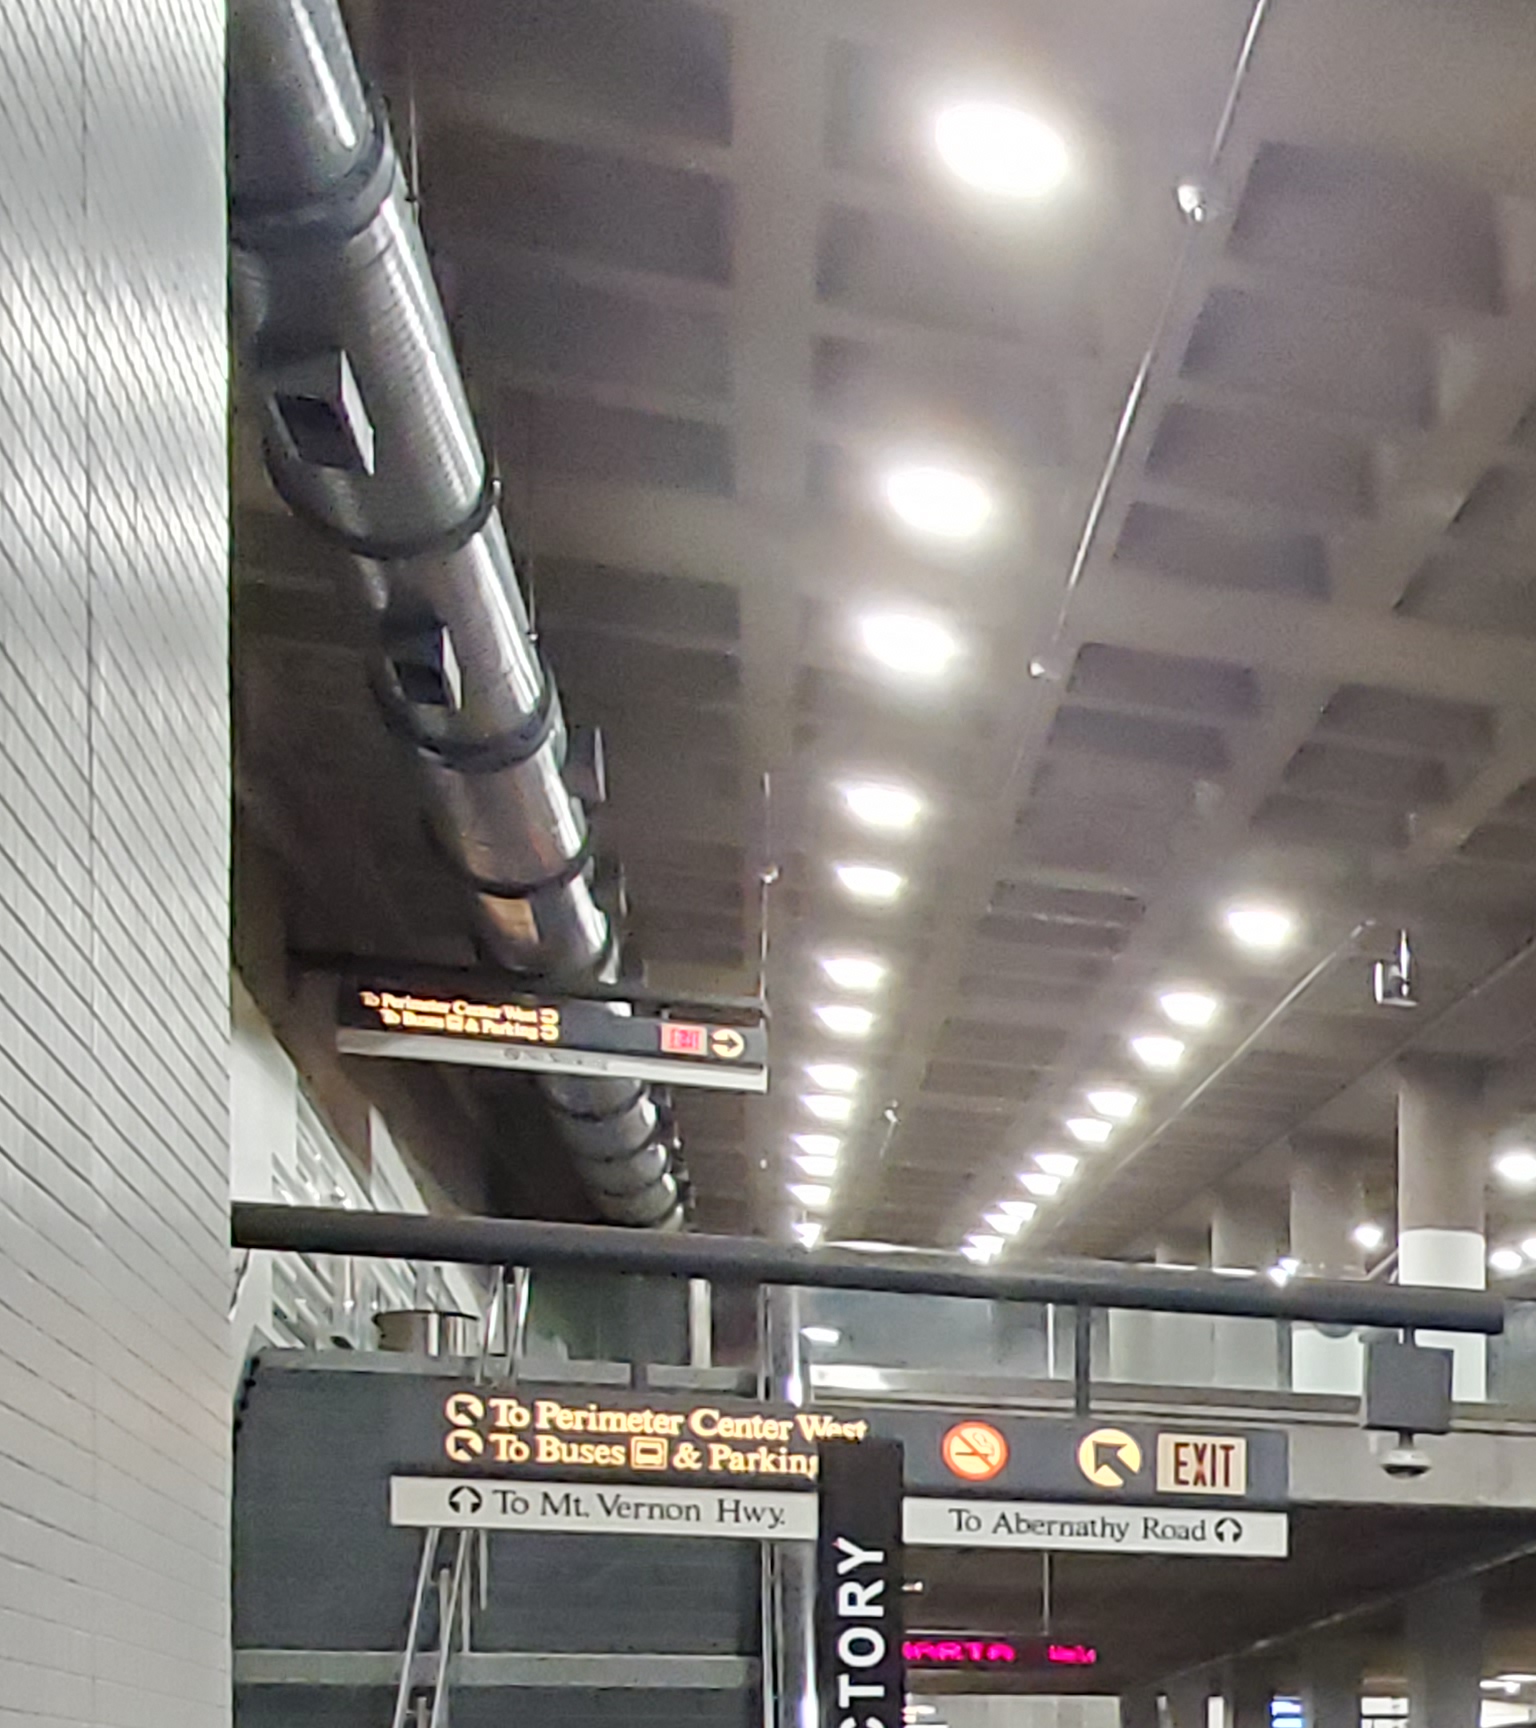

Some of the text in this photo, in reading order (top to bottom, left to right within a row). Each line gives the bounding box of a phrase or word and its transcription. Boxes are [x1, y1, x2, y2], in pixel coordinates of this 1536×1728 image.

[489, 1398, 867, 1442] To Perimeter Center West
[489, 1434, 530, 1462] To
[536, 1436, 626, 1466] Buses
[673, 1444, 702, 1469] &
[1173, 1442, 1235, 1488] EXIT
[493, 1489, 786, 1527] To Mt. Vernon Hwy.
[948, 1509, 1206, 1542] To Abernathy Road
